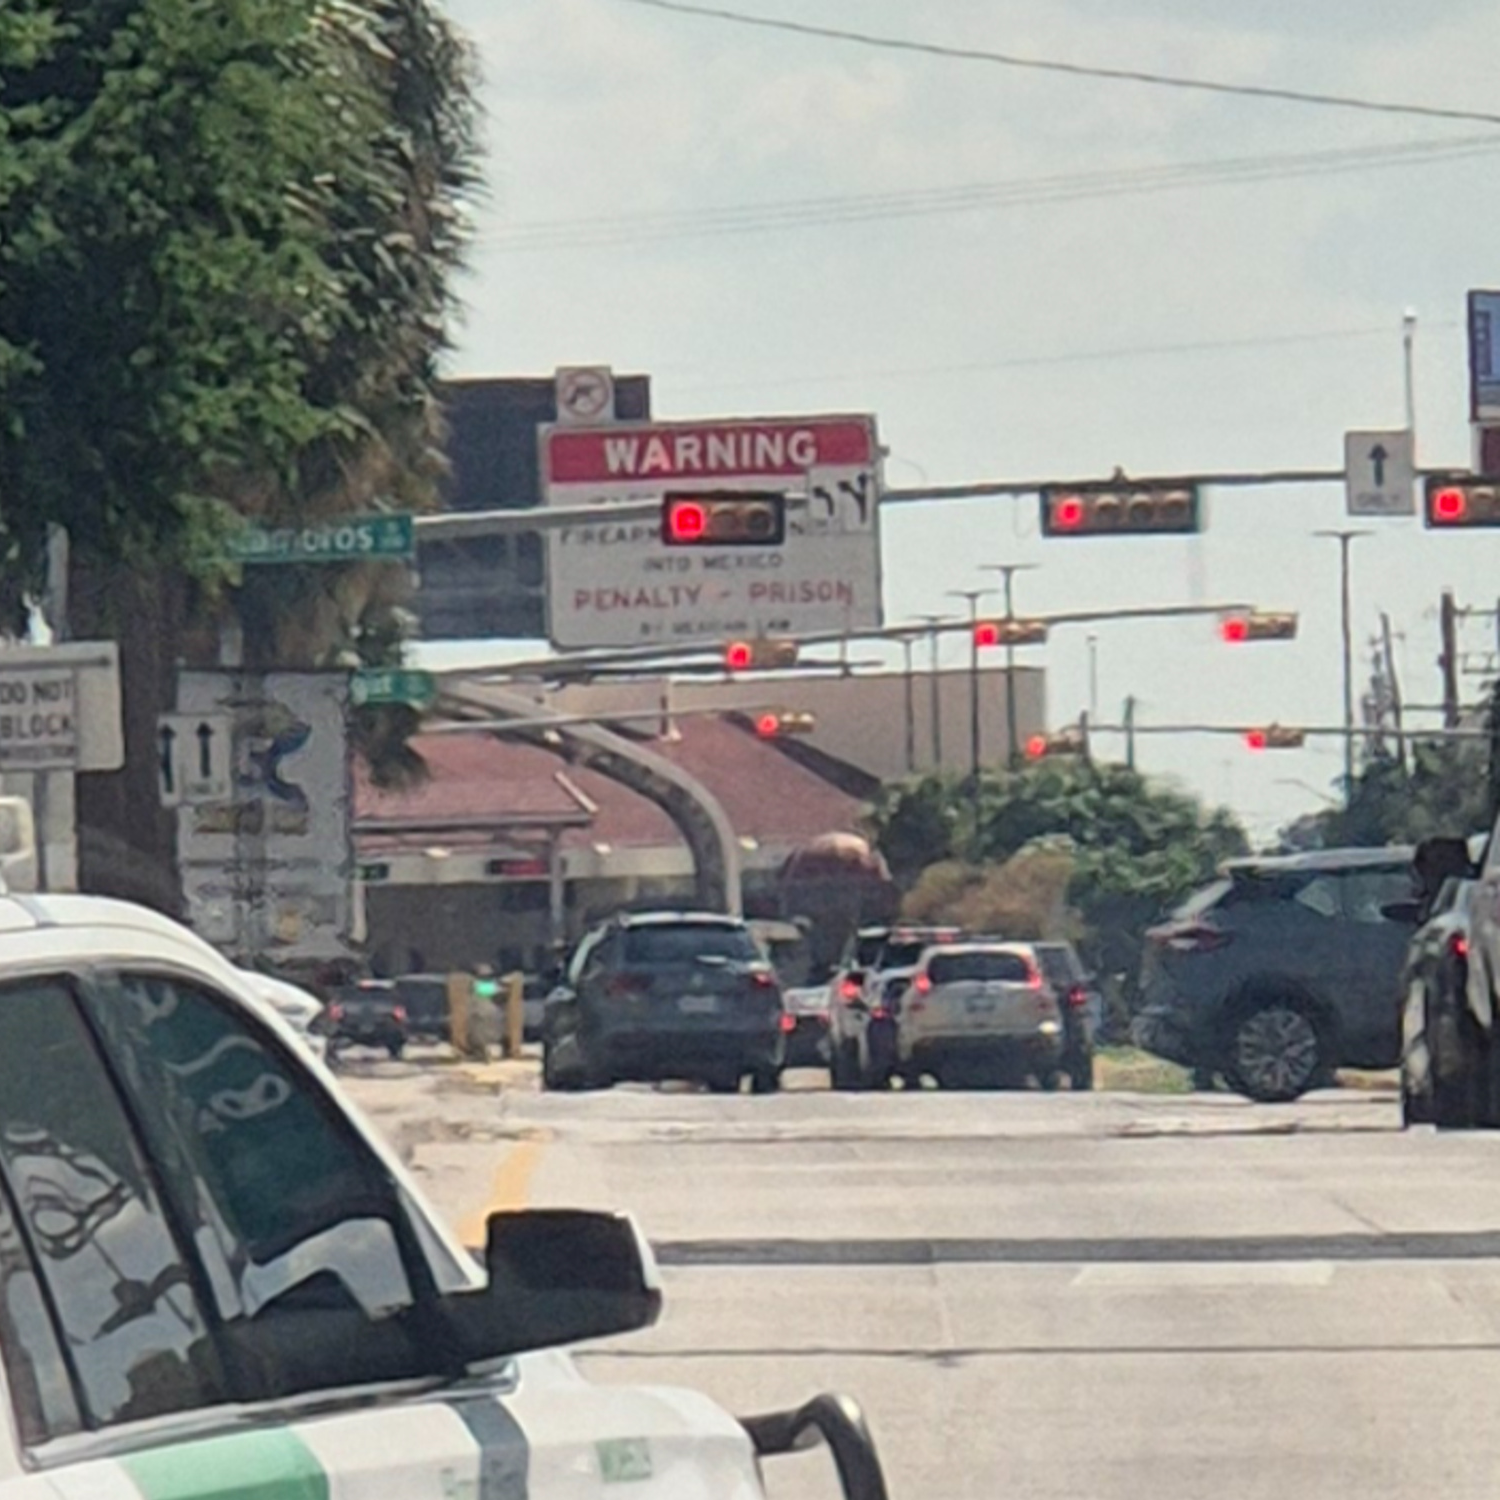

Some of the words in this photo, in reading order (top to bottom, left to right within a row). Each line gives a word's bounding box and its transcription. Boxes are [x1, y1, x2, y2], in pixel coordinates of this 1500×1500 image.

[602, 430, 818, 474] WARNING
[574, 585, 701, 611] PENALTY
[749, 580, 854, 606] PRISON
